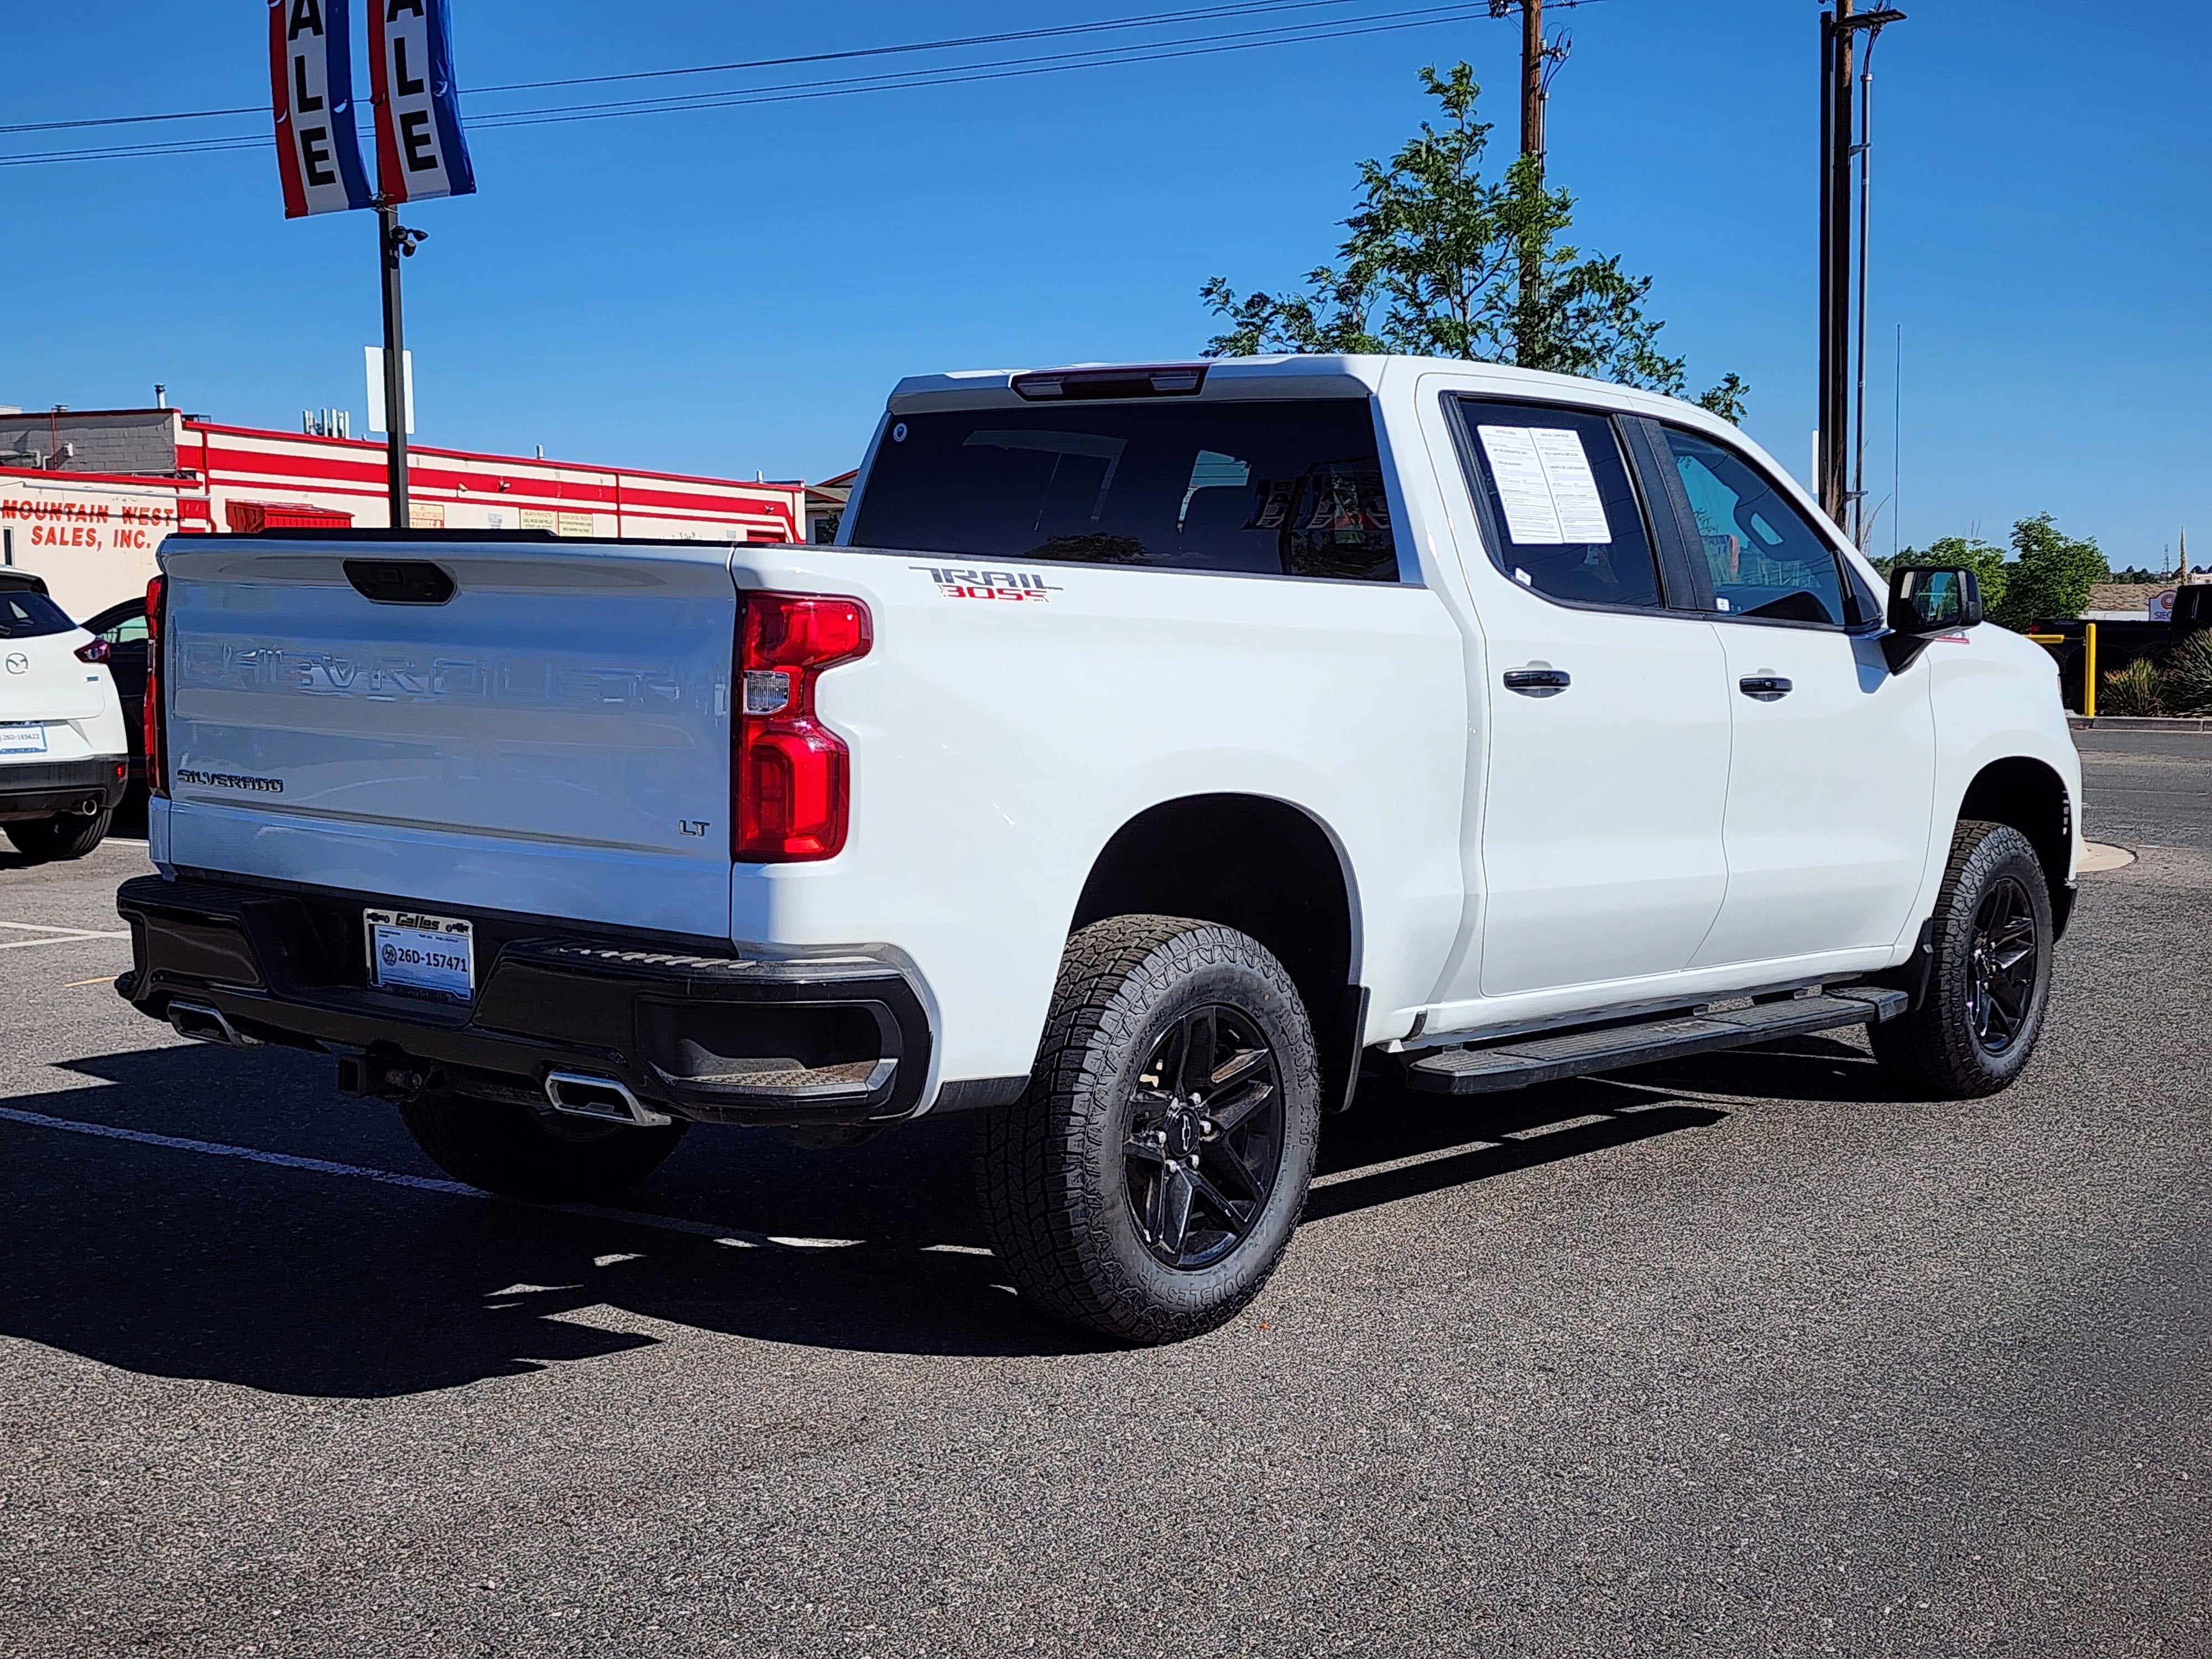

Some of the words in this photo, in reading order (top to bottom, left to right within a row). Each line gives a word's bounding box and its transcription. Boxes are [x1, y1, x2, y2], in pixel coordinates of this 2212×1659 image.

[1, 499, 109, 524] MOUNTAIN
[122, 505, 175, 527] WEST
[31, 525, 102, 551] SALES,
[113, 529, 152, 549] INC.
[908, 566, 1063, 591] TRAIL
[177, 769, 284, 793] SILVERADO
[678, 818, 711, 837] LT
[395, 912, 441, 931] Galles
[398, 947, 468, 973] 26D-157471
